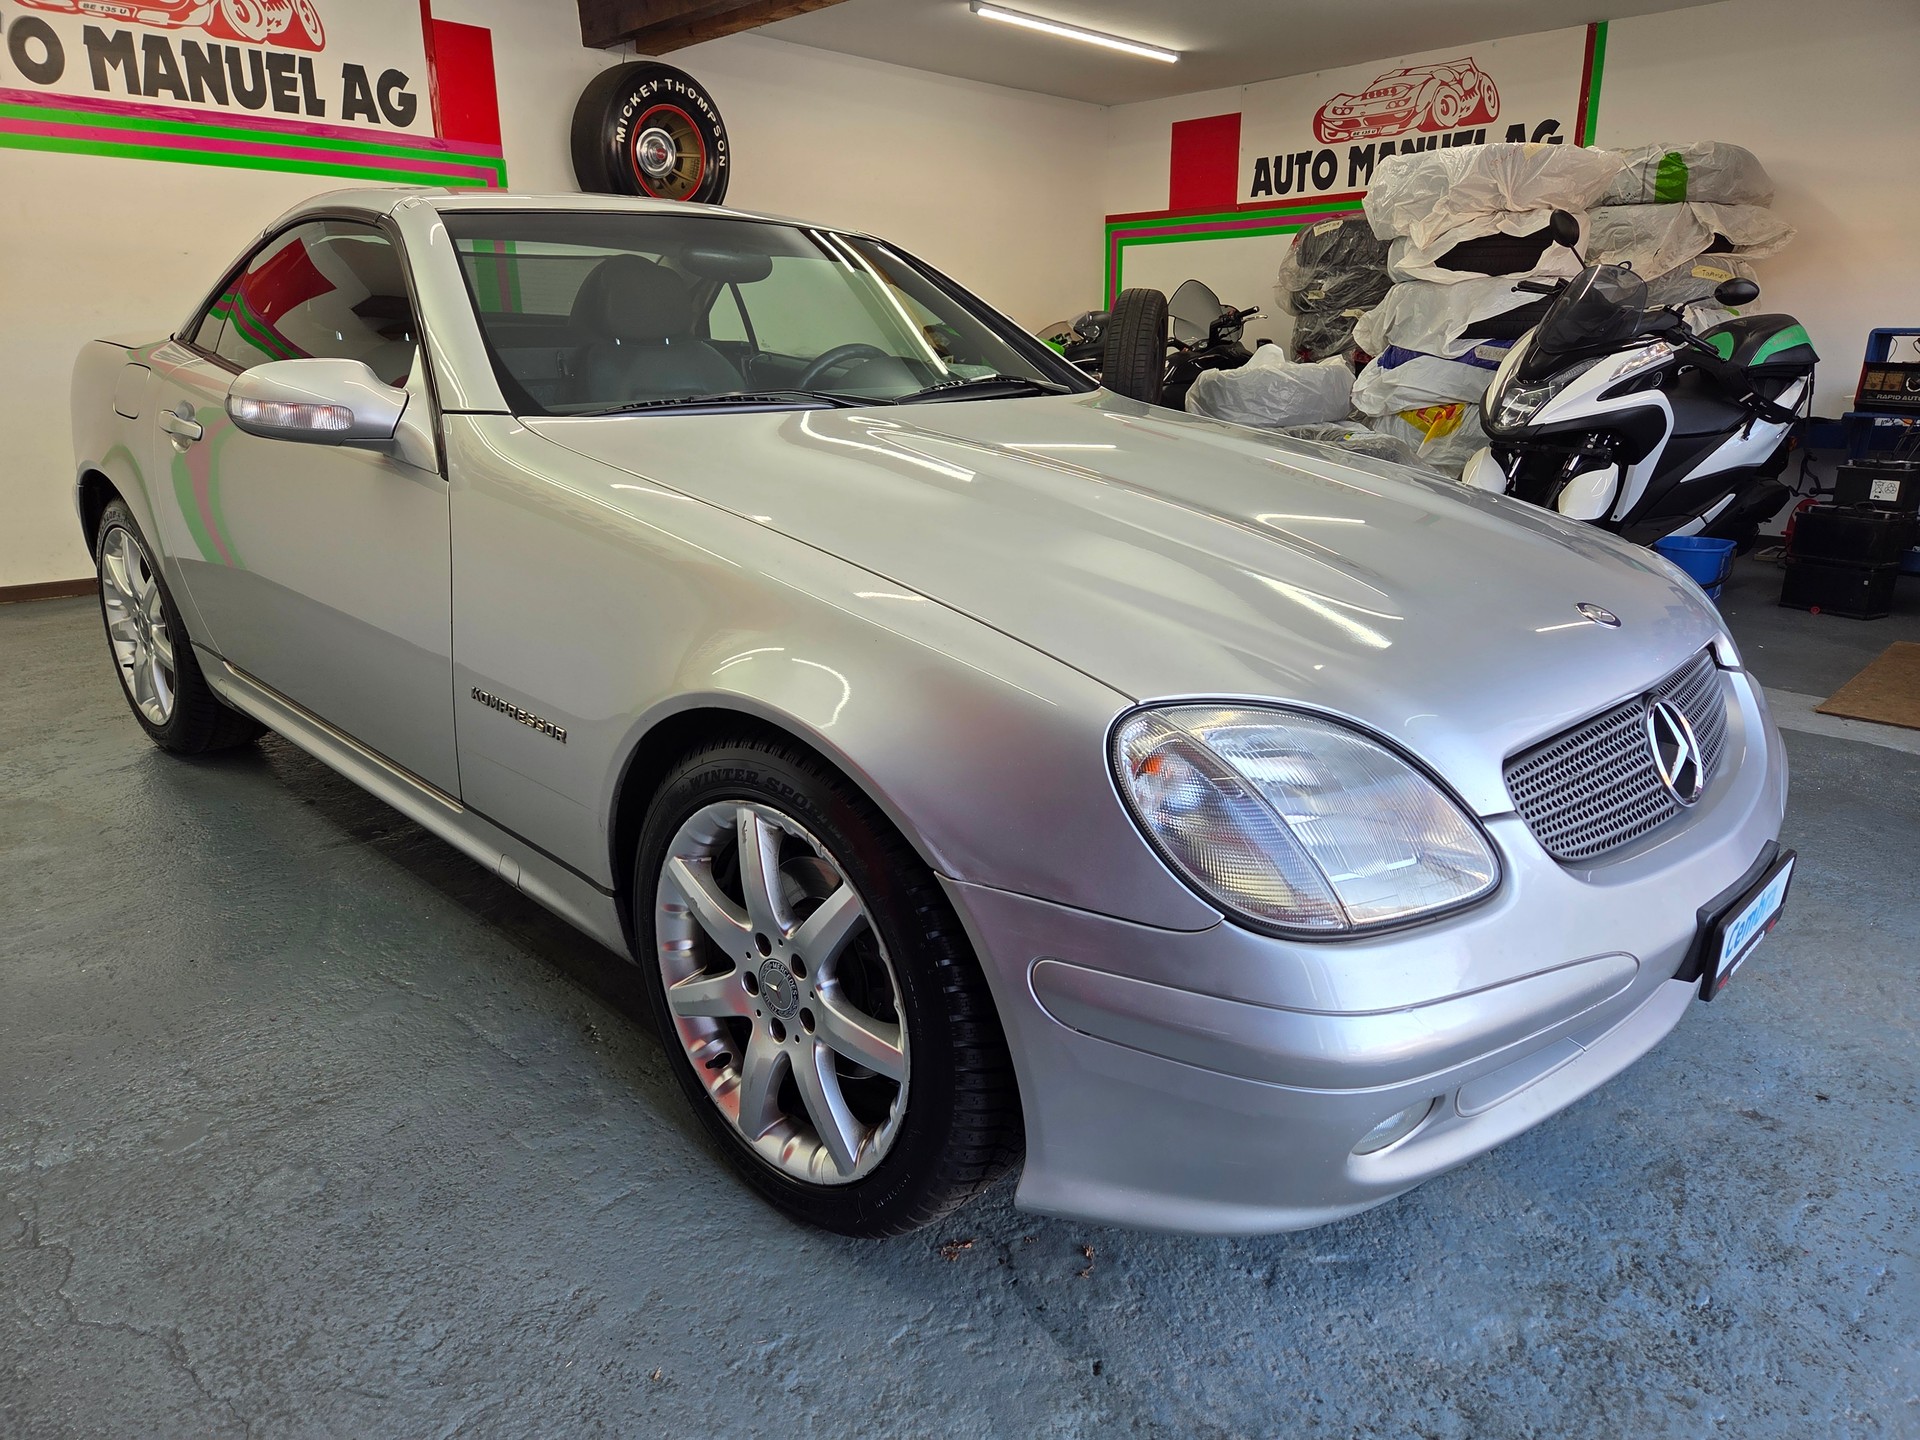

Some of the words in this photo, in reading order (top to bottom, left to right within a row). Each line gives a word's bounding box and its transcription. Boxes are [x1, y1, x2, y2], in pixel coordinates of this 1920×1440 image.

[100, 5, 117, 13] 135
[0, 9, 66, 86] O
[83, 24, 326, 117] MANUEL
[341, 62, 417, 128] AG
[616, 80, 658, 143] MICKEY
[664, 78, 726, 167] THOMPSON
[1250, 148, 1338, 197] AUTO
[470, 686, 567, 744] KOMPRESSOR
[689, 768, 760, 790] WINTER
